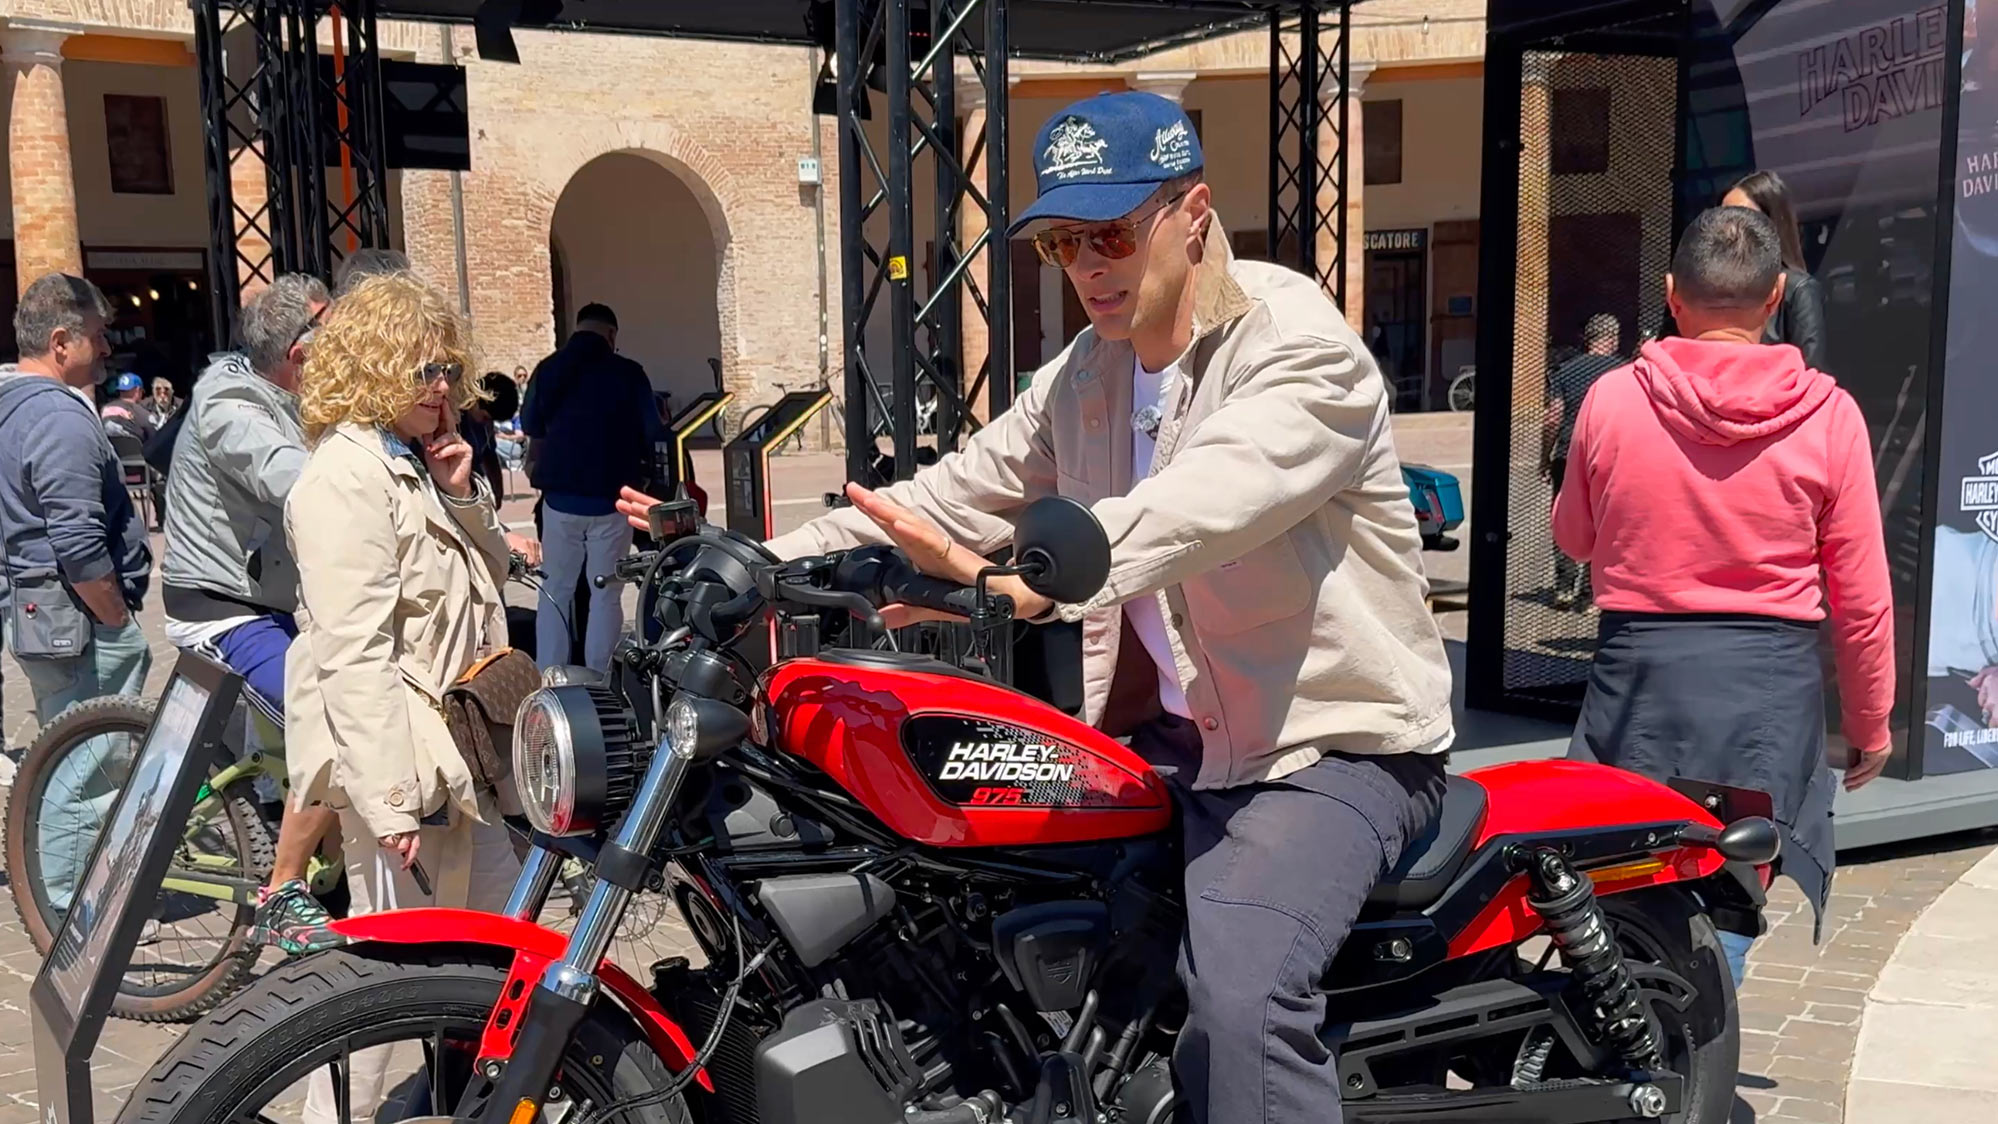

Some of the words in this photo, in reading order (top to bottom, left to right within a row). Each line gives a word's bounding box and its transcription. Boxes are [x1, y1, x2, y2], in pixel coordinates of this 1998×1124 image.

[1799, 5, 1947, 116] HARLE
[1842, 58, 1944, 133] DAVI
[1363, 232, 1419, 250] SCATORE
[948, 743, 1058, 763] HARLEY-
[939, 762, 1075, 782] DAVIDSON
[970, 787, 1023, 804] 975
[224, 1007, 329, 1085] DUNLOP
